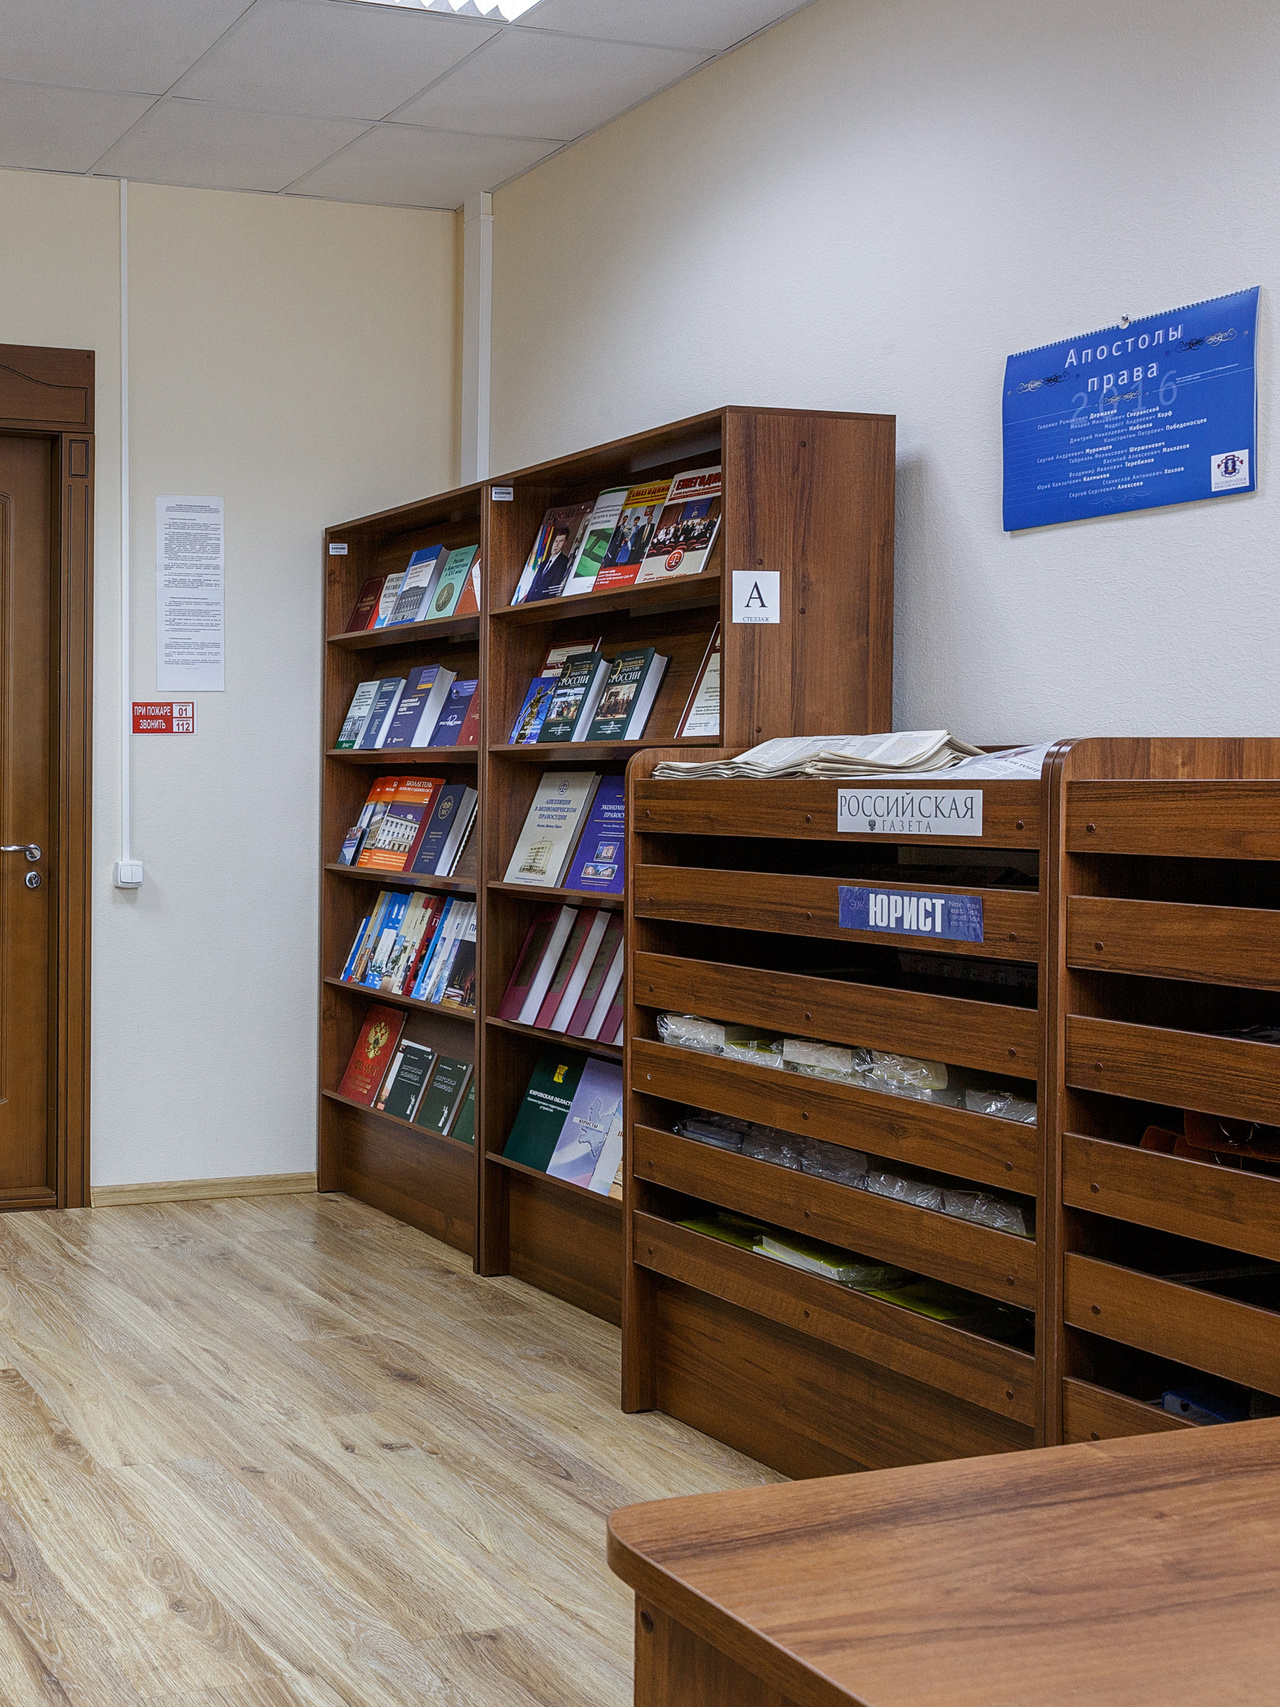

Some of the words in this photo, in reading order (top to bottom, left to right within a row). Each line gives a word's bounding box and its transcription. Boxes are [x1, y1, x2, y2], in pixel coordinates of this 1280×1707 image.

[1064, 324, 1184, 368] Апостолы
[1088, 361, 1159, 393] права
[1071, 370, 1178, 423] 2016
[1089, 409, 1118, 420] Державин
[1104, 421, 1124, 429] Модест
[1126, 415, 1156, 425] Андреевич
[1157, 410, 1173, 419] Корф
[1126, 406, 1160, 418] Сперанский
[1069, 434, 1093, 444] Дмитрий
[1128, 422, 1153, 431] Набоков
[1103, 433, 1136, 443] Константин
[1137, 427, 1164, 437] Петрович
[1165, 418, 1207, 431] Победоносцев
[1037, 456, 1054, 464] Сергей
[1055, 451, 1084, 460] Андреевич
[1085, 444, 1113, 455] Муромцев
[1128, 449, 1161, 460] Алексеевич
[1162, 443, 1190, 454] Маклаков
[1129, 441, 1165, 453] Шершеневич
[1096, 464, 1123, 473] Иванович
[1124, 457, 1155, 468] Теребилов
[1083, 473, 1110, 482] Калмыков
[1102, 476, 1131, 485] Станислав
[1132, 471, 1163, 480] Антонович
[1164, 466, 1185, 475] Хохлов
[1069, 490, 1087, 498] Сергей
[1088, 486, 1116, 495] Сергеевич
[1117, 481, 1144, 490] Алексеев
[744, 581, 768, 608] А
[134, 706, 146, 716] ПРИ
[147, 706, 171, 716] ПОЖАРЕ
[178, 707, 188, 717] 01
[139, 719, 167, 730] ЗВОНИТЬ
[176, 722, 191, 732] 112
[839, 791, 975, 820] РОССИЙСКАЯ
[882, 820, 932, 833] ГАЗЕТА
[529, 1089, 554, 1101] КИРОВСКАЯ
